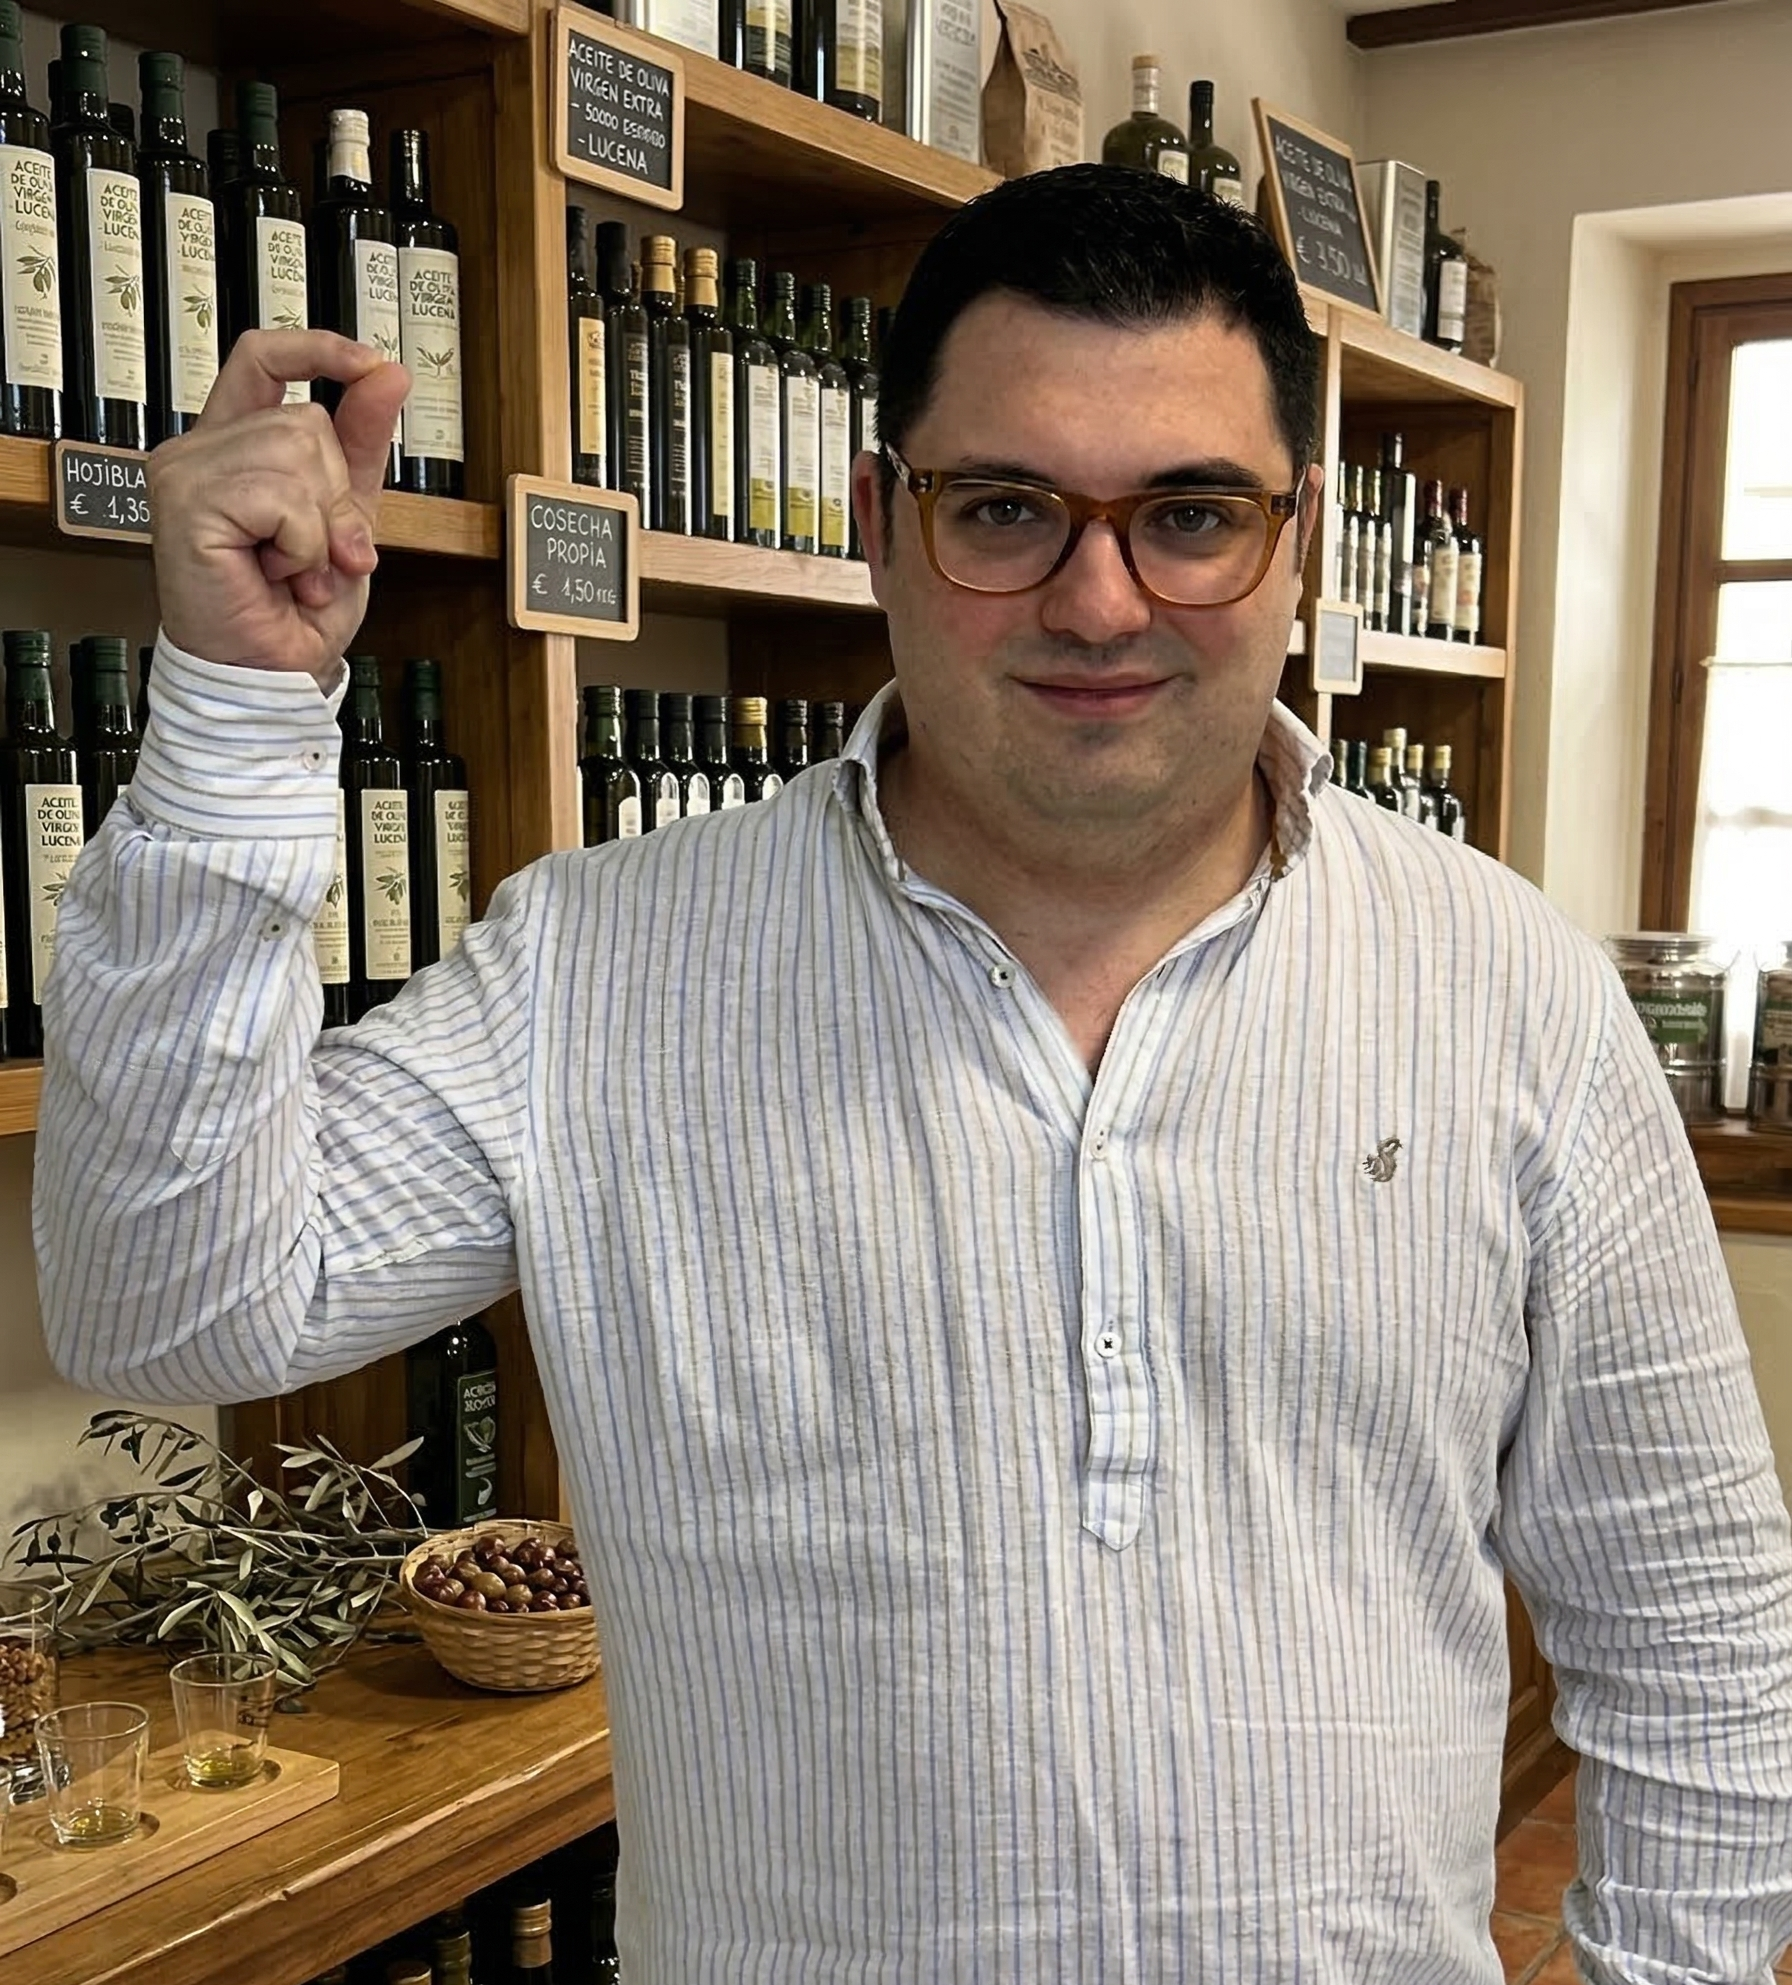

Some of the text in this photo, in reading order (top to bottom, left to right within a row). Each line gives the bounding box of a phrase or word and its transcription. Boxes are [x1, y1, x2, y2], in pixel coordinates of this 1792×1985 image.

[568, 38, 669, 97] ACEITE DE OLIVA
[570, 66, 664, 121] VIRGEN EXTRA
[588, 133, 648, 174] LUCENA
[11, 173, 26, 185] DE
[69, 493, 89, 515] €
[530, 504, 613, 542] COSECHA
[546, 537, 607, 569] PROPIA
[531, 573, 548, 595] €
[560, 577, 594, 604] 1,50
